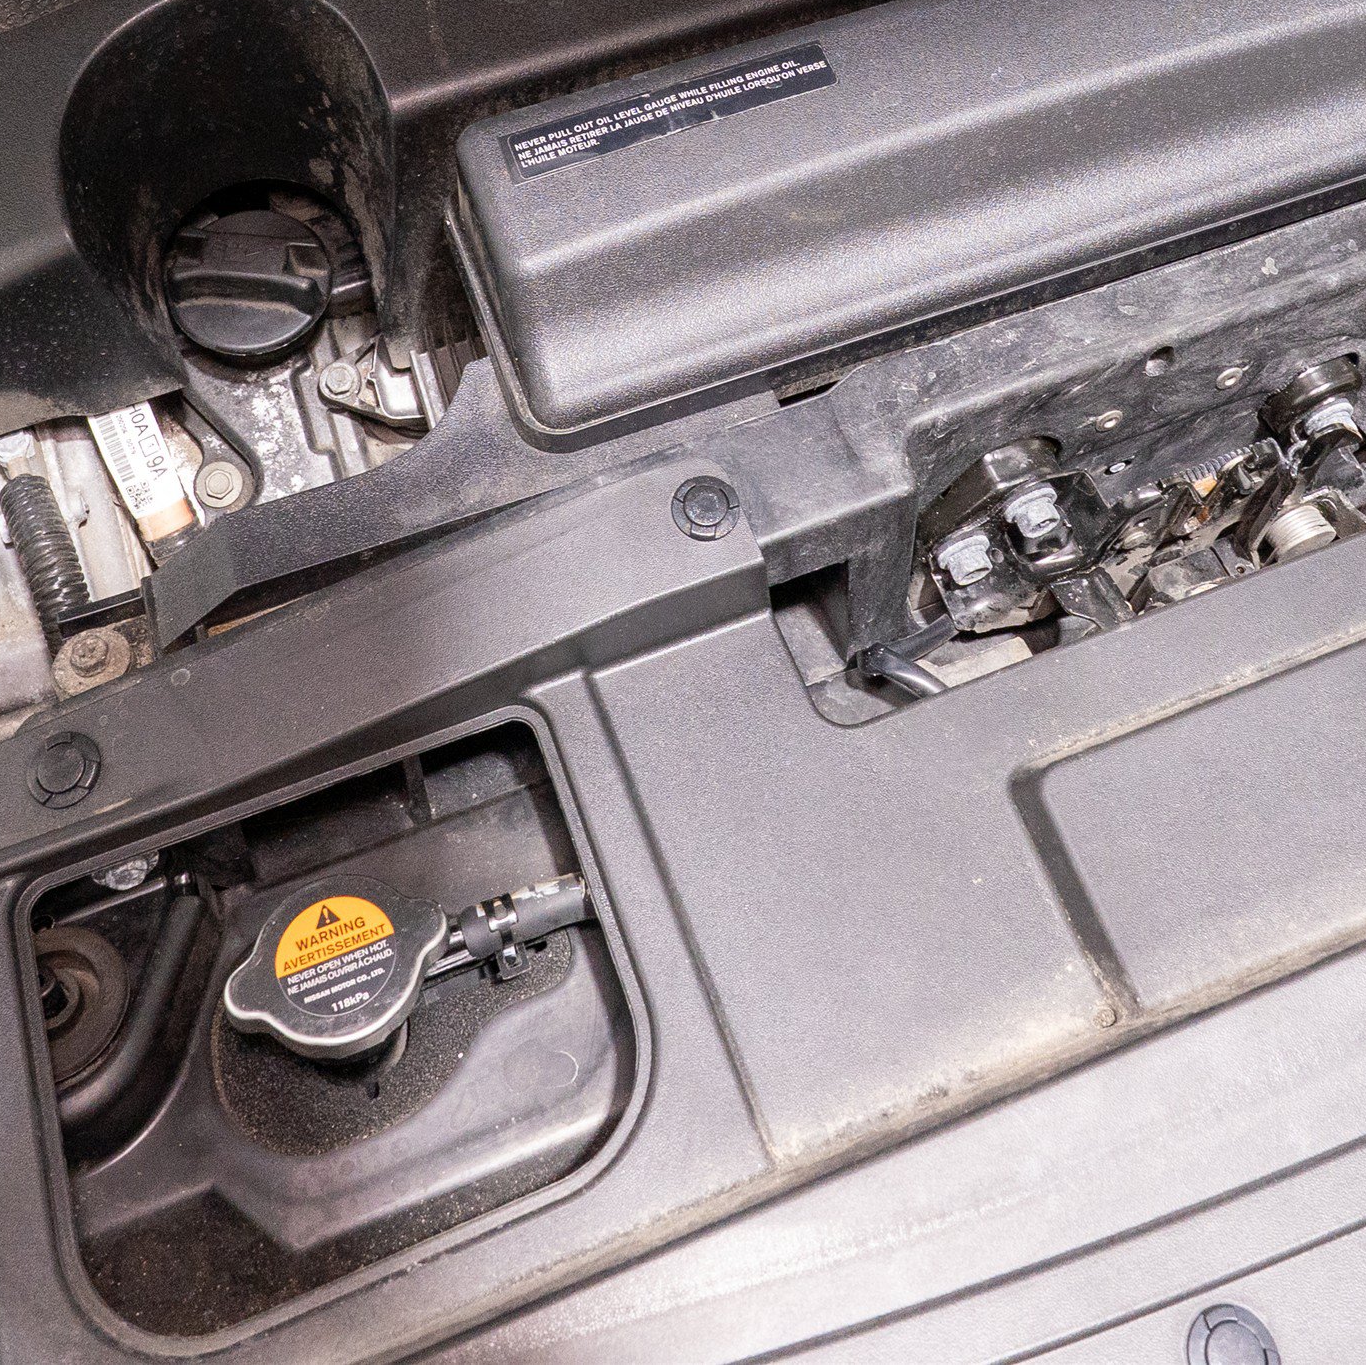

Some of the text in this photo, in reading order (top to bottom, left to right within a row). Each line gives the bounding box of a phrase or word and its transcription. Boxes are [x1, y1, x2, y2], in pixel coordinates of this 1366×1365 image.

[514, 59, 801, 152] NEVER PULL OUT OIL LEVEL GAUGE WHILE FILLING ENGINE OIL.
[518, 60, 827, 161] NE JAMAIS RETIRER LA JAUGE DE NIVEAU D'HUILE LORSQU'ON VERSE
[520, 139, 600, 168] L'HUILE MOTEUR.
[283, 923, 386, 972] AVERTISSEMENT
[296, 916, 366, 951] WARNING
[287, 939, 390, 985] NEVER OPEN WHEN HOT.
[287, 986, 300, 996] NE
[300, 976, 327, 992] JAMAIS
[327, 962, 359, 980] OUVRIR
[363, 948, 394, 966] CHAUD.
[303, 989, 331, 1004] NISSAN
[331, 979, 356, 994] MOTOR
[370, 967, 385, 979] LTD.
[331, 991, 370, 1012] 118kPa
